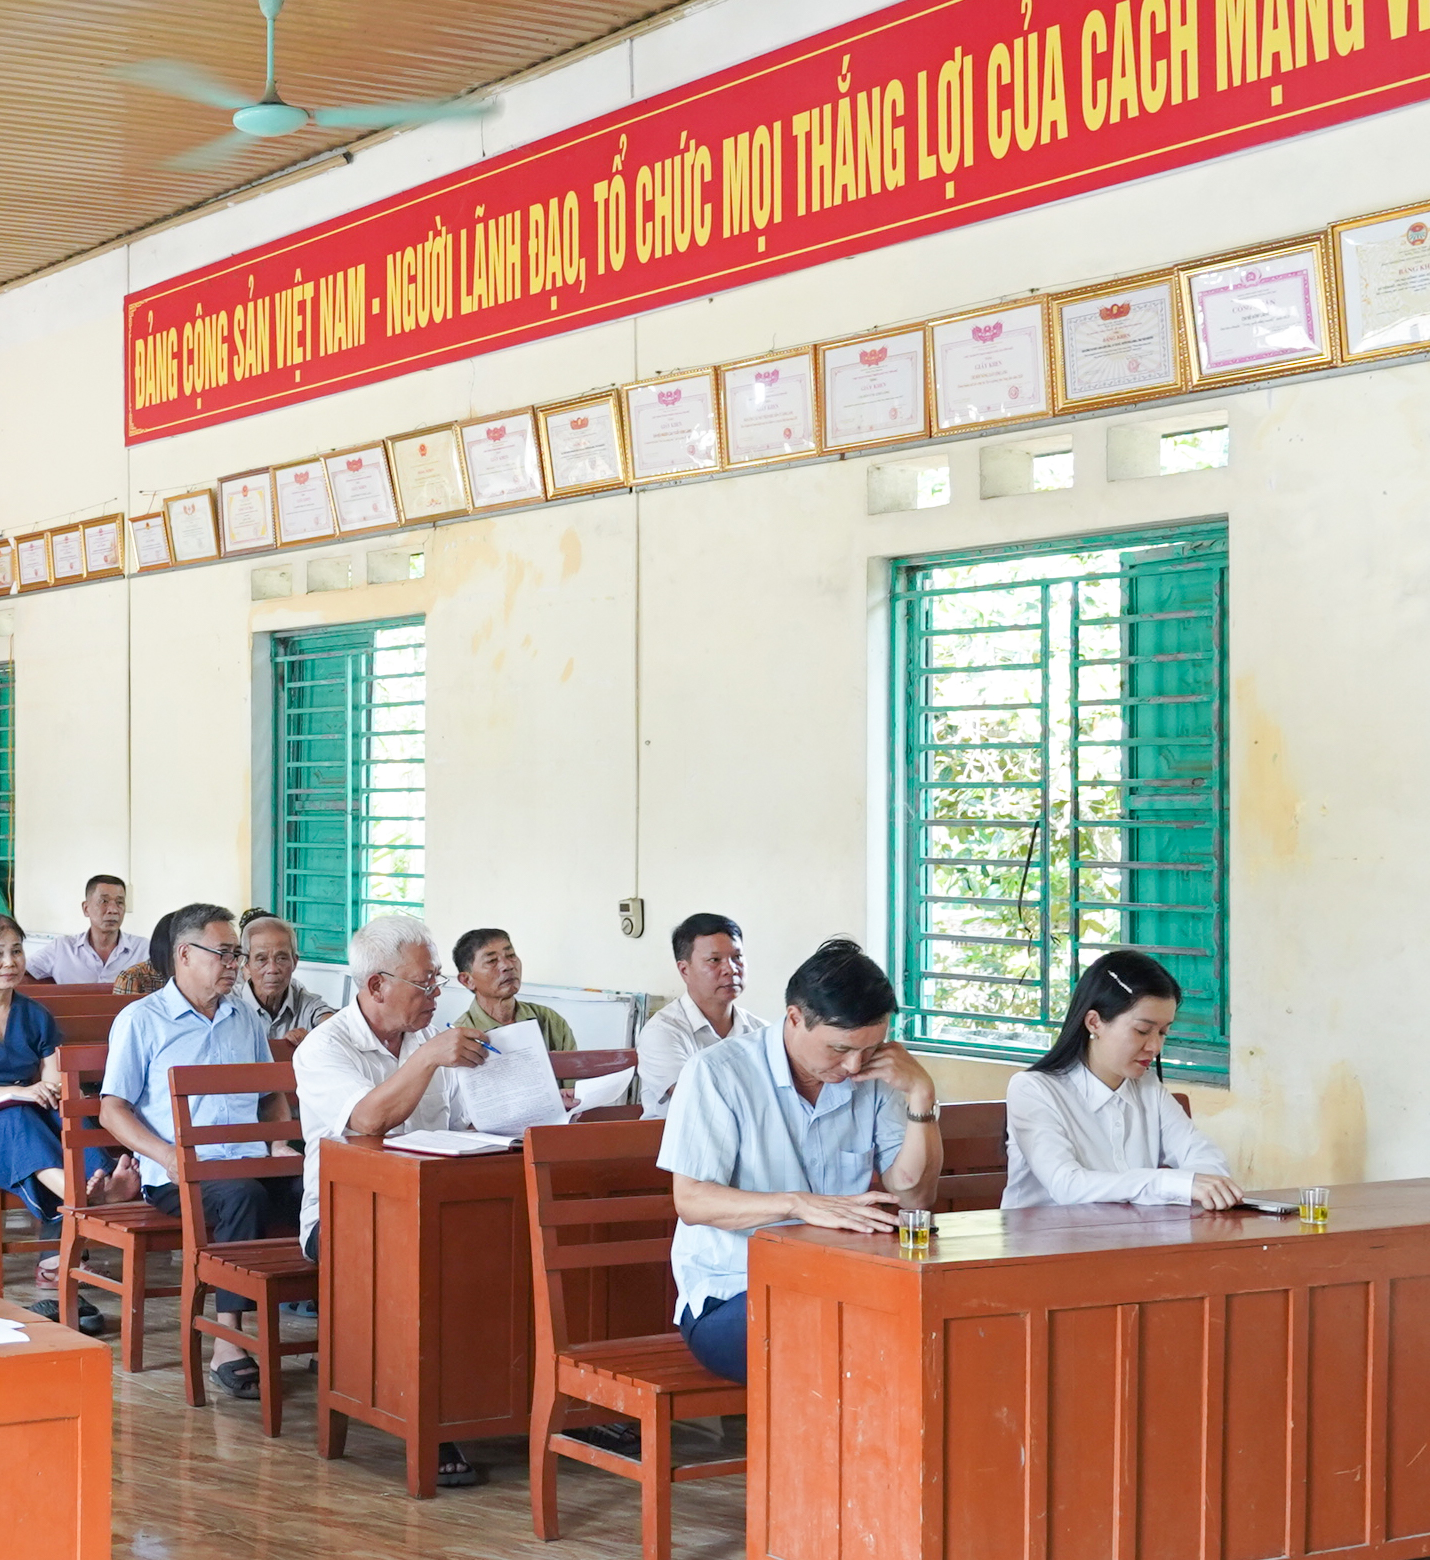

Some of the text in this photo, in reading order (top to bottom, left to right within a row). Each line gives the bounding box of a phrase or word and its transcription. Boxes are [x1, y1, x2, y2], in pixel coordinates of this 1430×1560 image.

[135, 310, 178, 410] ĐẢNG
[183, 303, 229, 410] CỘNG
[233, 275, 270, 381] SẢN
[275, 268, 315, 383] VIỆT
[320, 264, 366, 357] NAM
[387, 216, 453, 338] NGƯỜI
[461, 204, 522, 316] LÃNH
[527, 191, 586, 311] ĐẠO,
[593, 133, 627, 276] TỔ
[636, 129, 712, 264] CHỨC
[723, 121, 782, 253] MỌI
[792, 54, 906, 217] THẮNG
[918, 46, 974, 200] LỢI
[988, 0, 1069, 160] CỦA
